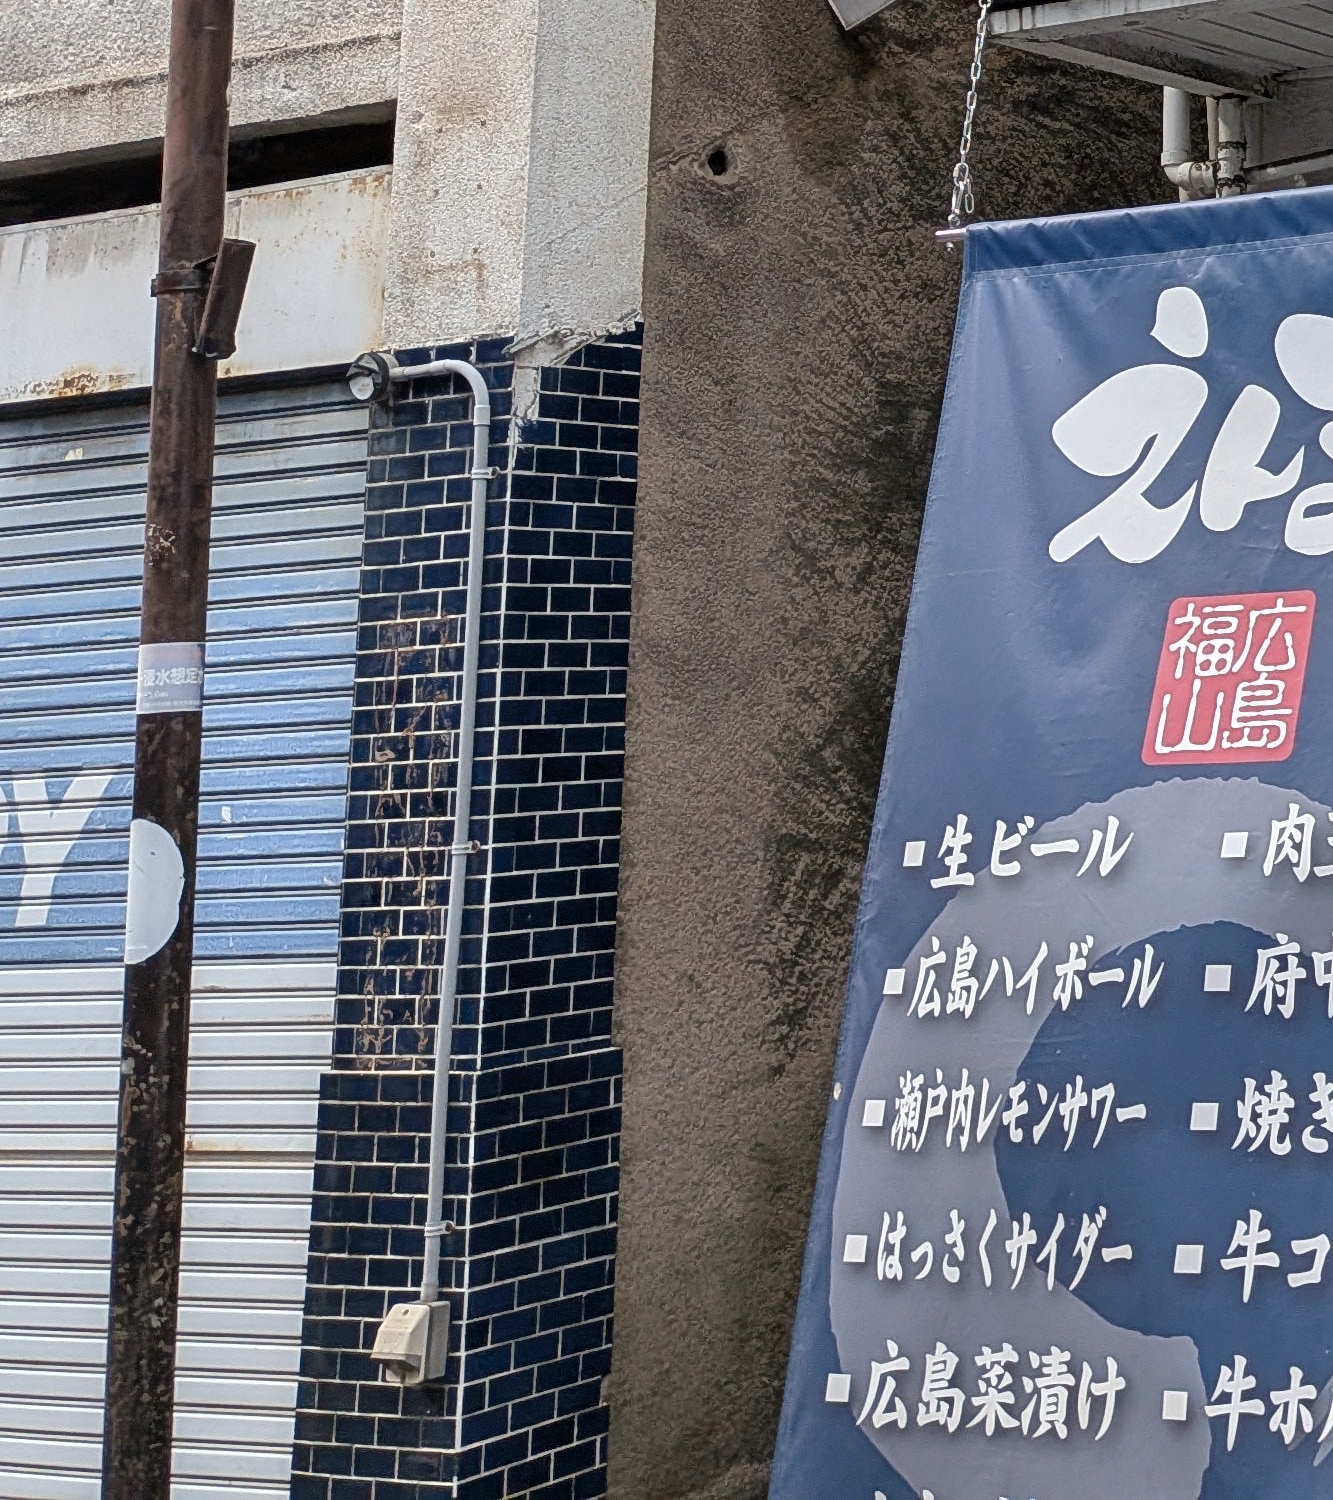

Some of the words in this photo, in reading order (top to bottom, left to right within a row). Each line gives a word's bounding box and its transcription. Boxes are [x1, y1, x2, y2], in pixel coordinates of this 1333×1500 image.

[929, 813, 1134, 889] 生ビール
[907, 934, 1165, 1019] 広島ハイボール
[890, 1067, 1148, 1151] 瀬戸内レモンサワー
[876, 1206, 1133, 1290] はっさくサイダー
[855, 1339, 1126, 1442] 広島菜漬け
